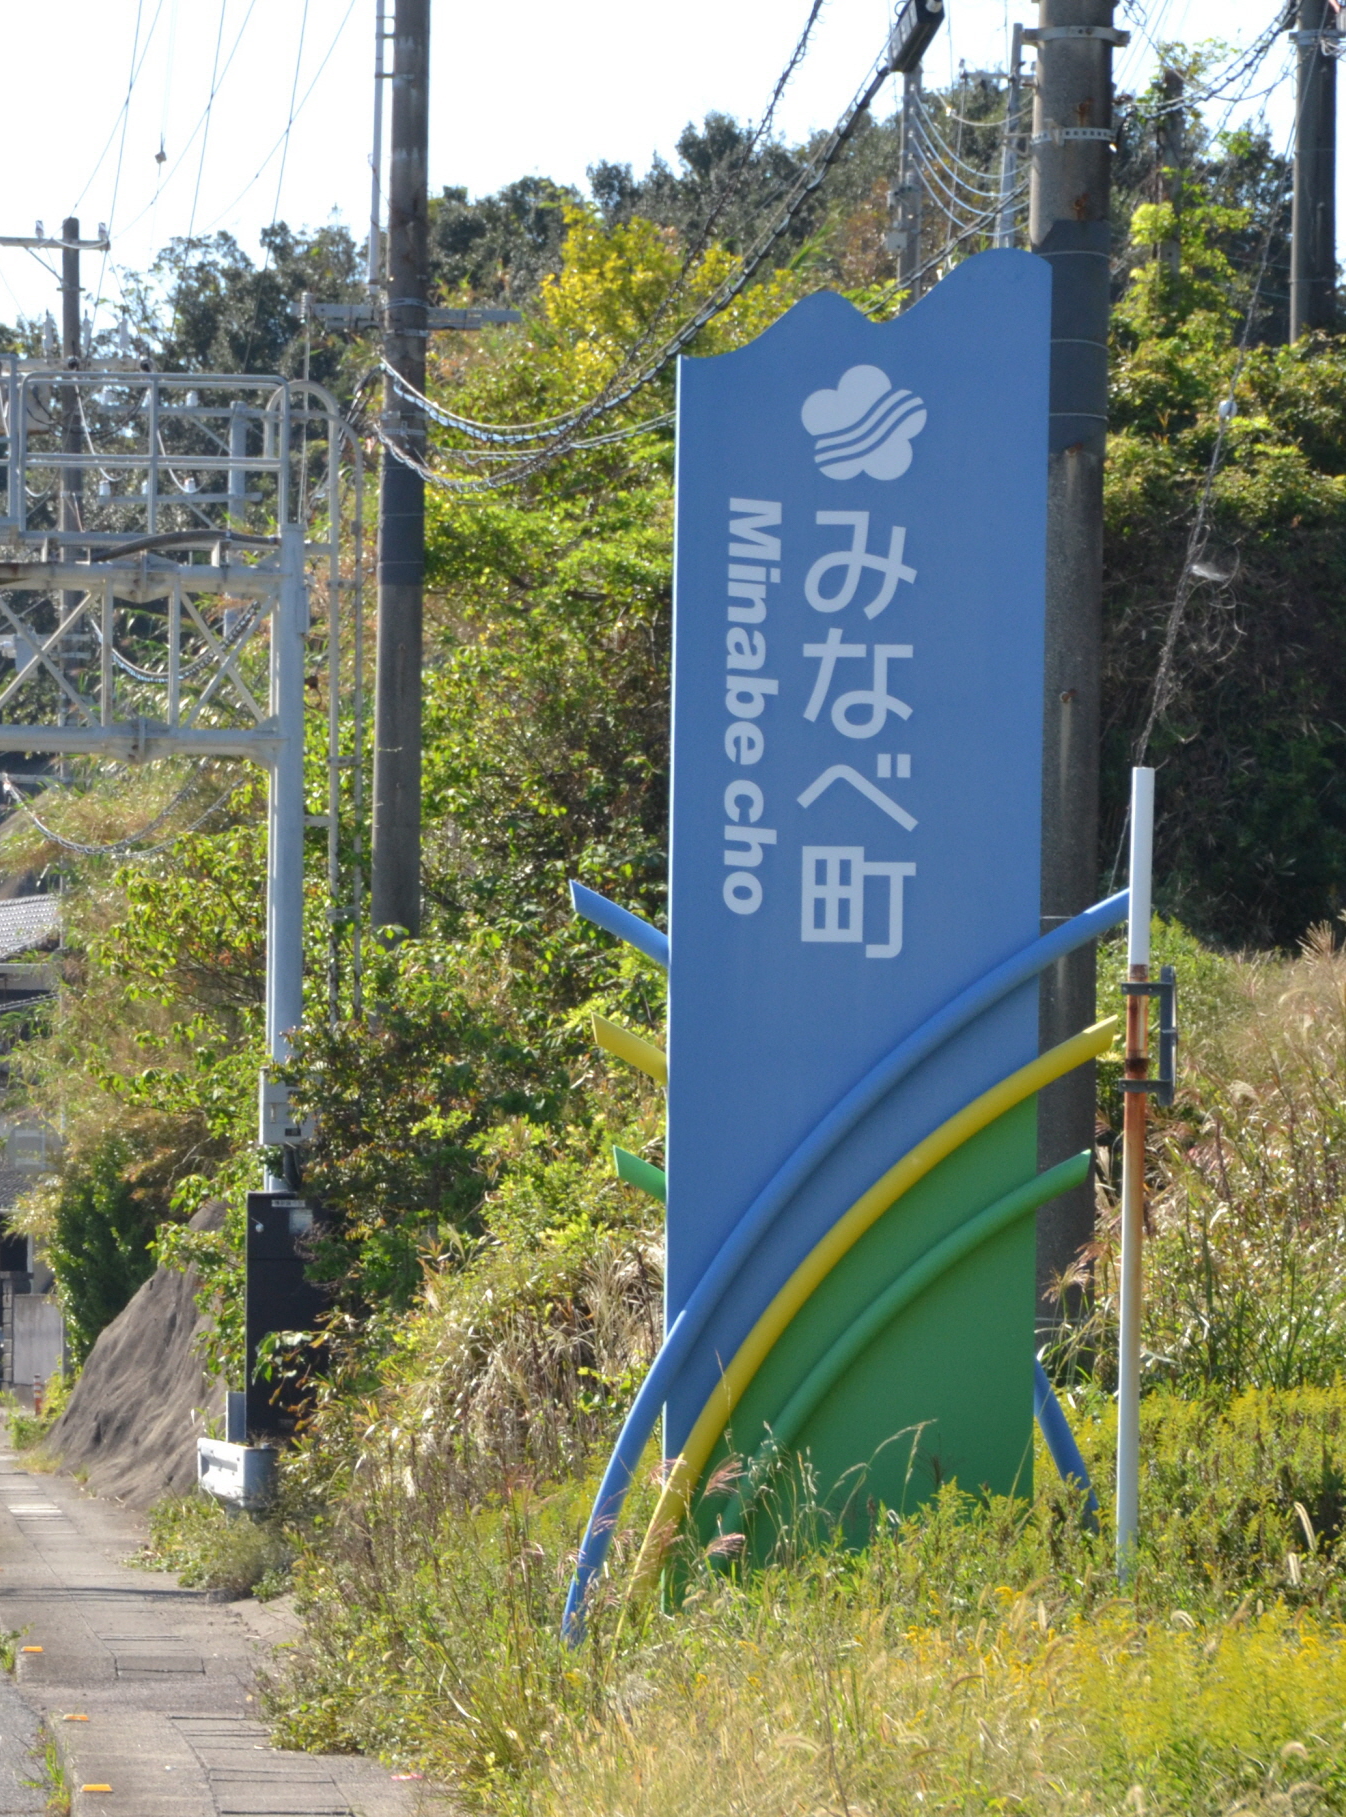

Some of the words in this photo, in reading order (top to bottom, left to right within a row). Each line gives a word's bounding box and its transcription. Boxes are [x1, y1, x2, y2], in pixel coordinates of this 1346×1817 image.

[724, 498, 783, 766] Minabe
[797, 510, 919, 959] みなべ町
[723, 780, 778, 915] cho
